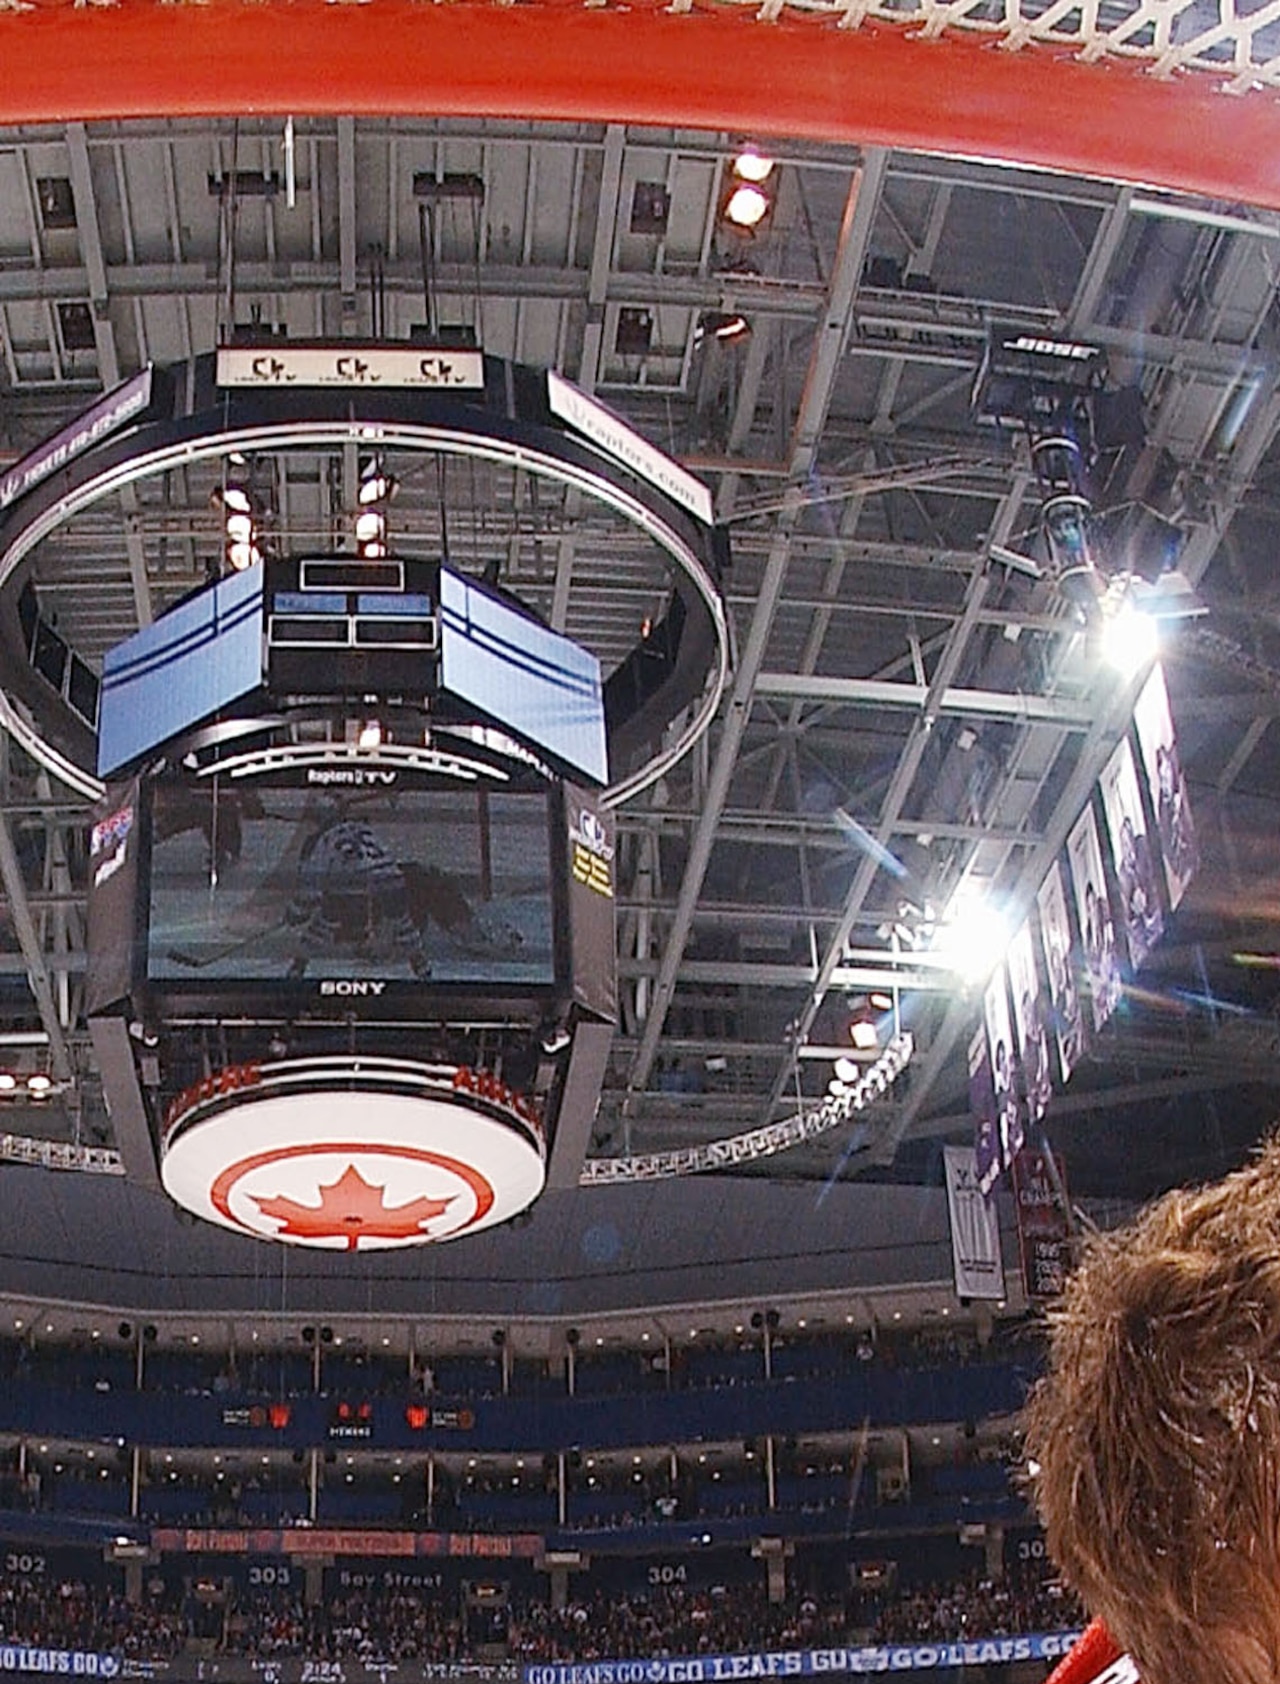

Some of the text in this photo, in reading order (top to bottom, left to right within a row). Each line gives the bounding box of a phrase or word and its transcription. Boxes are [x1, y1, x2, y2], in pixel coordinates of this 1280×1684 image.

[364, 771, 397, 784] TV
[320, 980, 386, 995] SONY
[5, 1554, 46, 1572] 302
[249, 1567, 291, 1585] 303
[648, 1565, 687, 1584] 304
[0, 1651, 15, 1670] O
[20, 1651, 70, 1673] LEAFS
[73, 1654, 98, 1676] GO
[617, 1662, 645, 1683] GO
[668, 1659, 702, 1683] GO
[713, 1652, 802, 1680] LEAFS
[810, 1650, 846, 1672] GO
[892, 1647, 938, 1668] GO
[950, 1638, 1032, 1665] LEAFS
